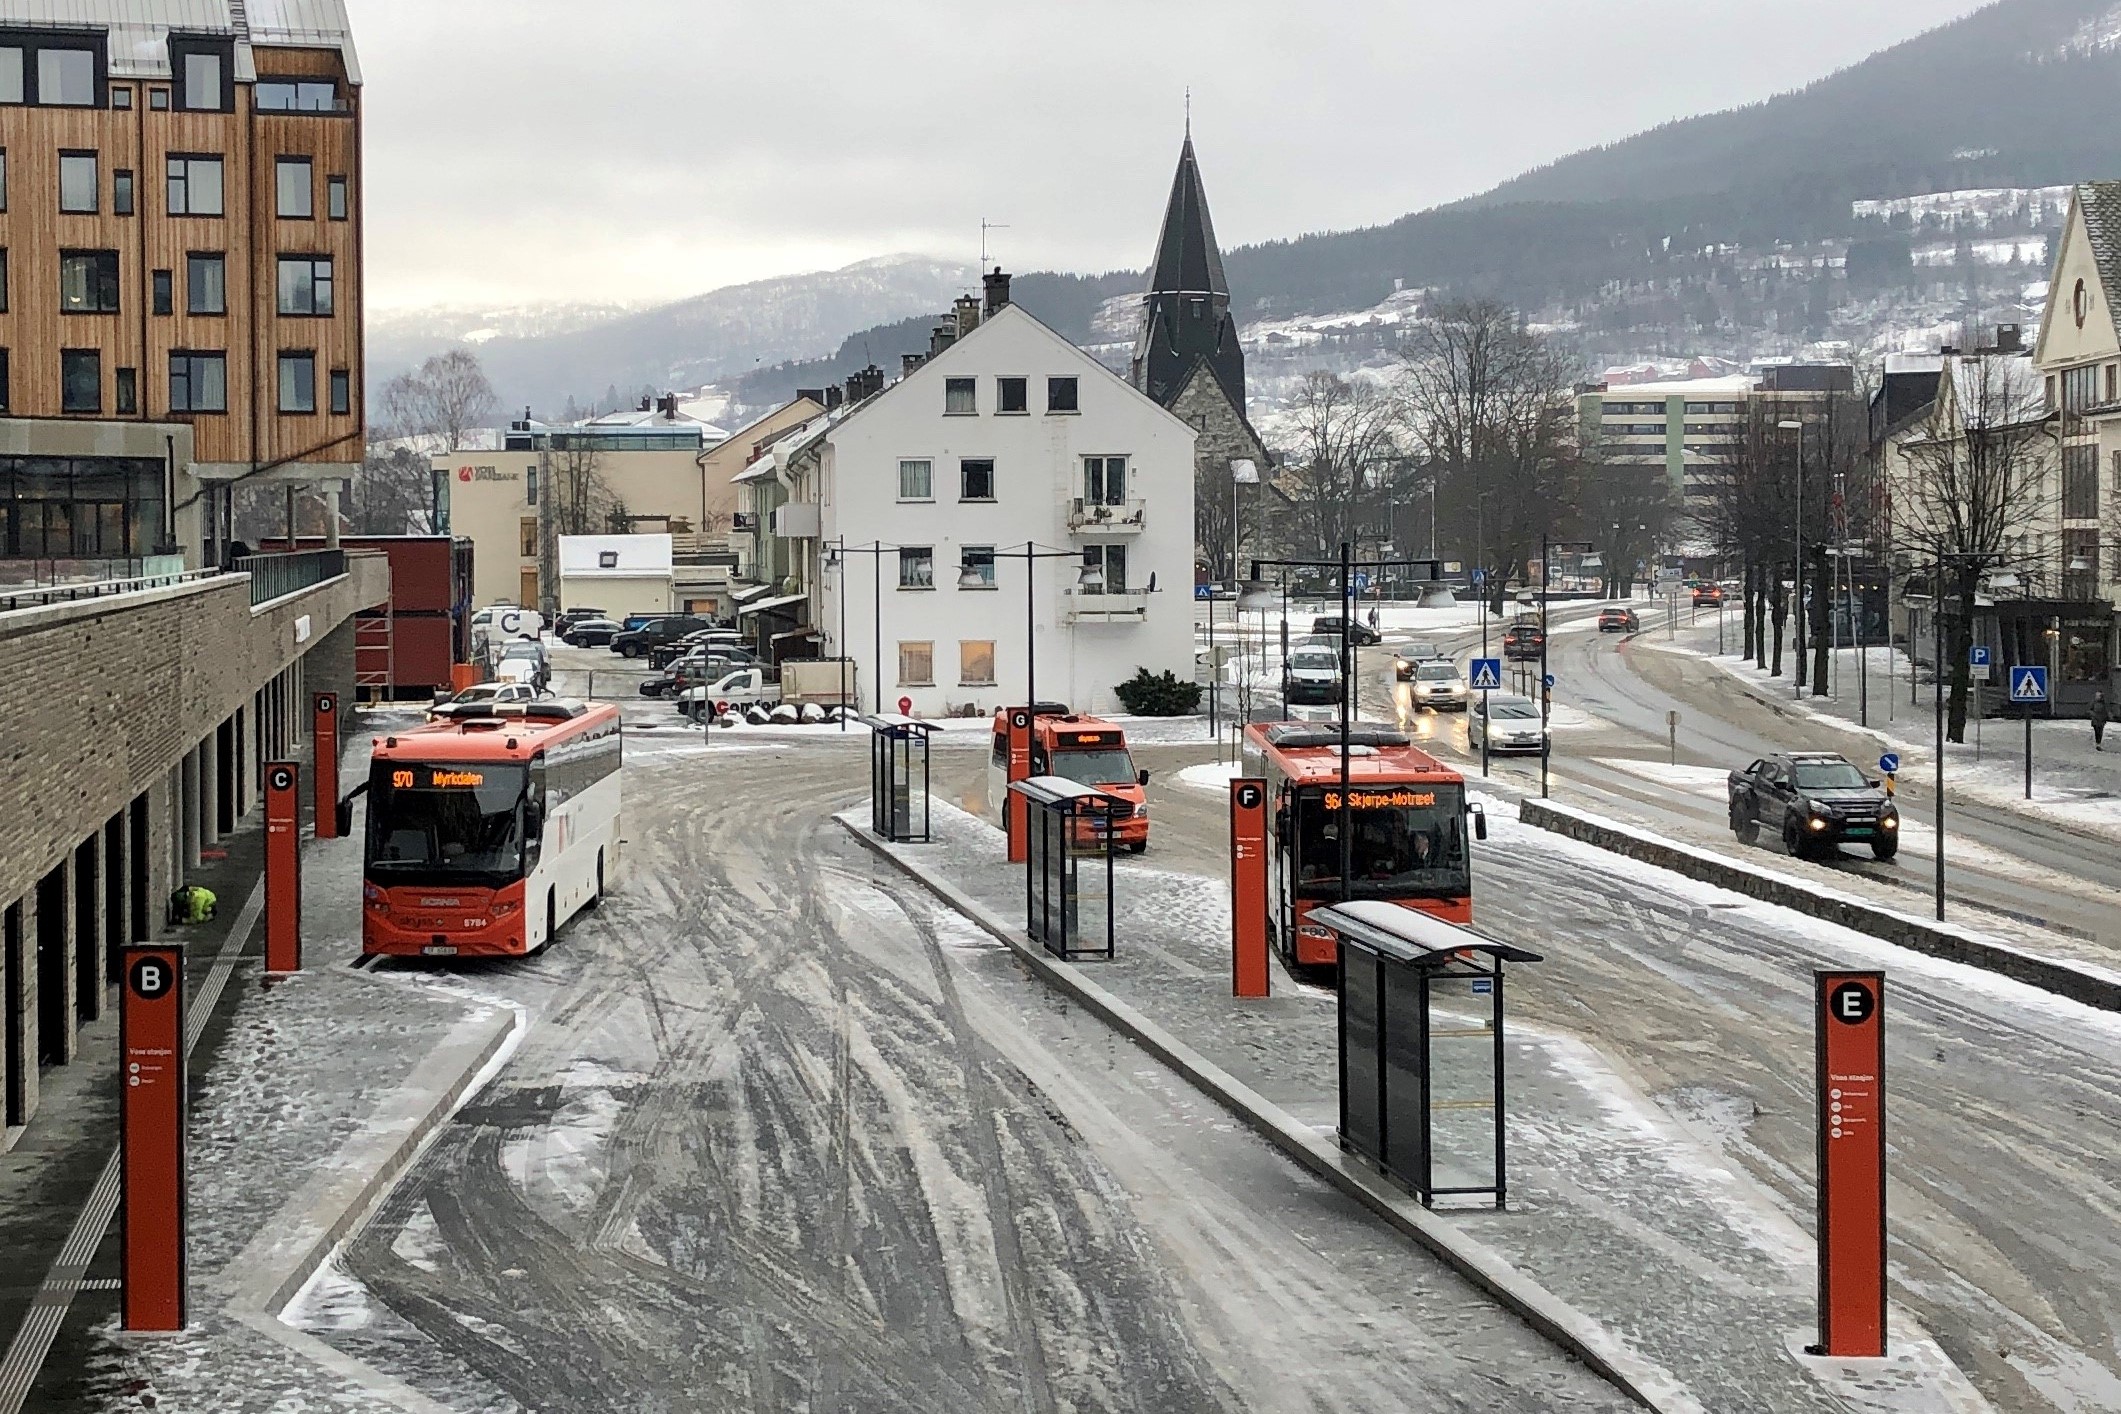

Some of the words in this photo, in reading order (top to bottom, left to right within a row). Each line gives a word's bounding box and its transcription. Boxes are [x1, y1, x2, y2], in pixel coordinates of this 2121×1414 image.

[1975, 649, 1986, 662] P
[321, 699, 330, 710] D
[1016, 715, 1026, 726] G
[275, 772, 287, 787] C
[393, 771, 413, 787] 970
[1243, 789, 1255, 805] F
[141, 966, 161, 991] B
[1843, 991, 1862, 1016] E
